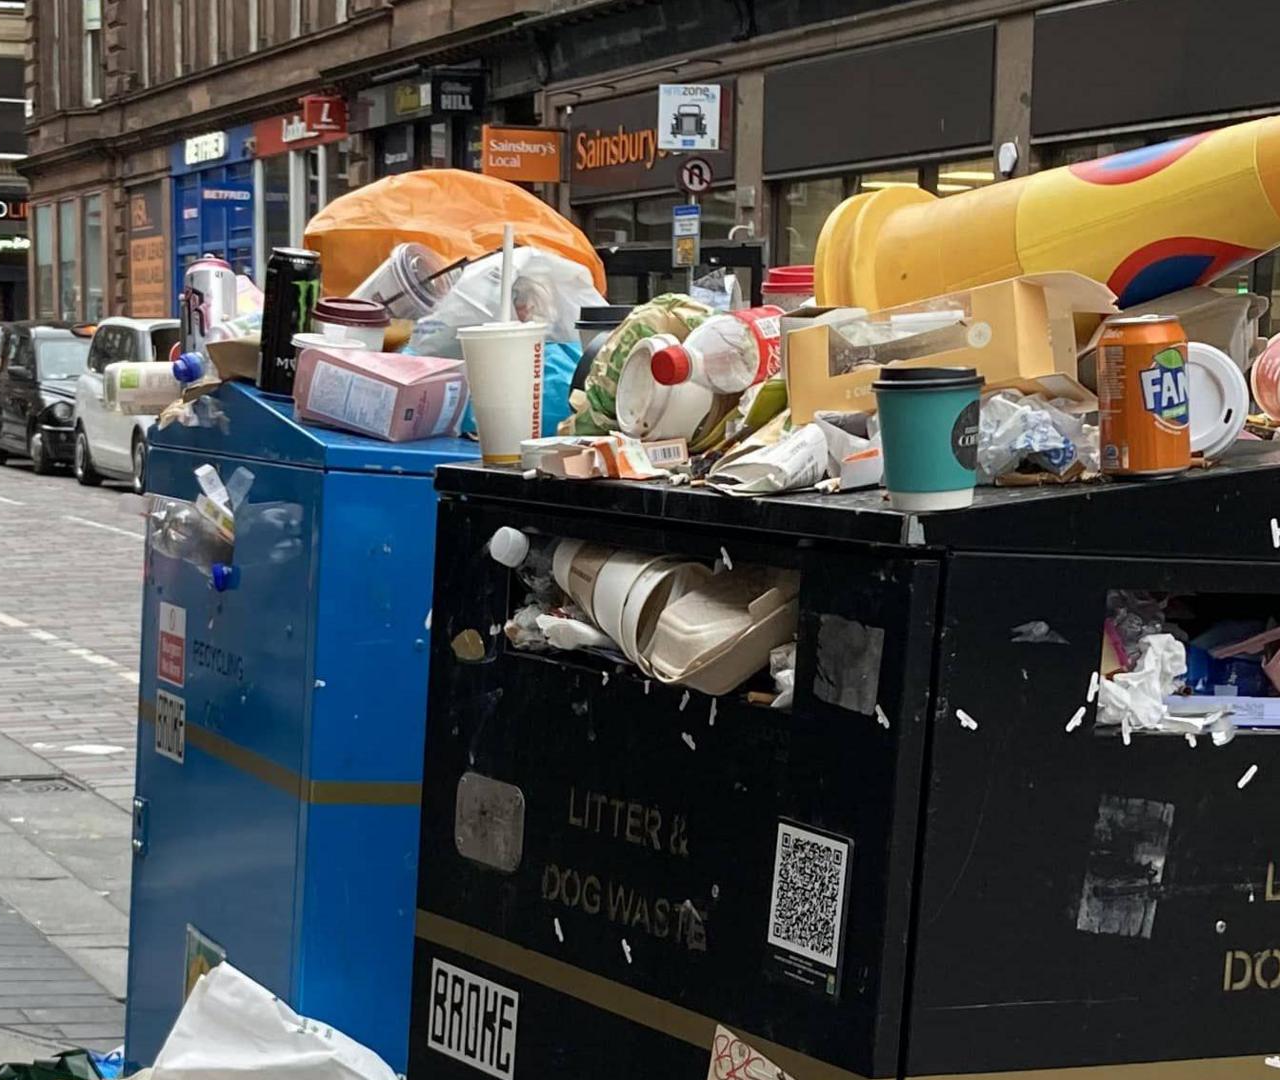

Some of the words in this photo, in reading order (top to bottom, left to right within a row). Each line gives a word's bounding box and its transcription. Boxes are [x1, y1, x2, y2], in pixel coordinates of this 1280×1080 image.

[440, 94, 472, 110] HILL
[489, 139, 556, 155] Sainsbury's
[489, 154, 521, 168] Local
[576, 125, 667, 170] Sainsbury
[533, 342, 542, 379] KING
[531, 381, 541, 440] BURGER
[568, 785, 662, 851] LITTER
[541, 862, 602, 916] DOG
[431, 967, 516, 1074] BROKE
